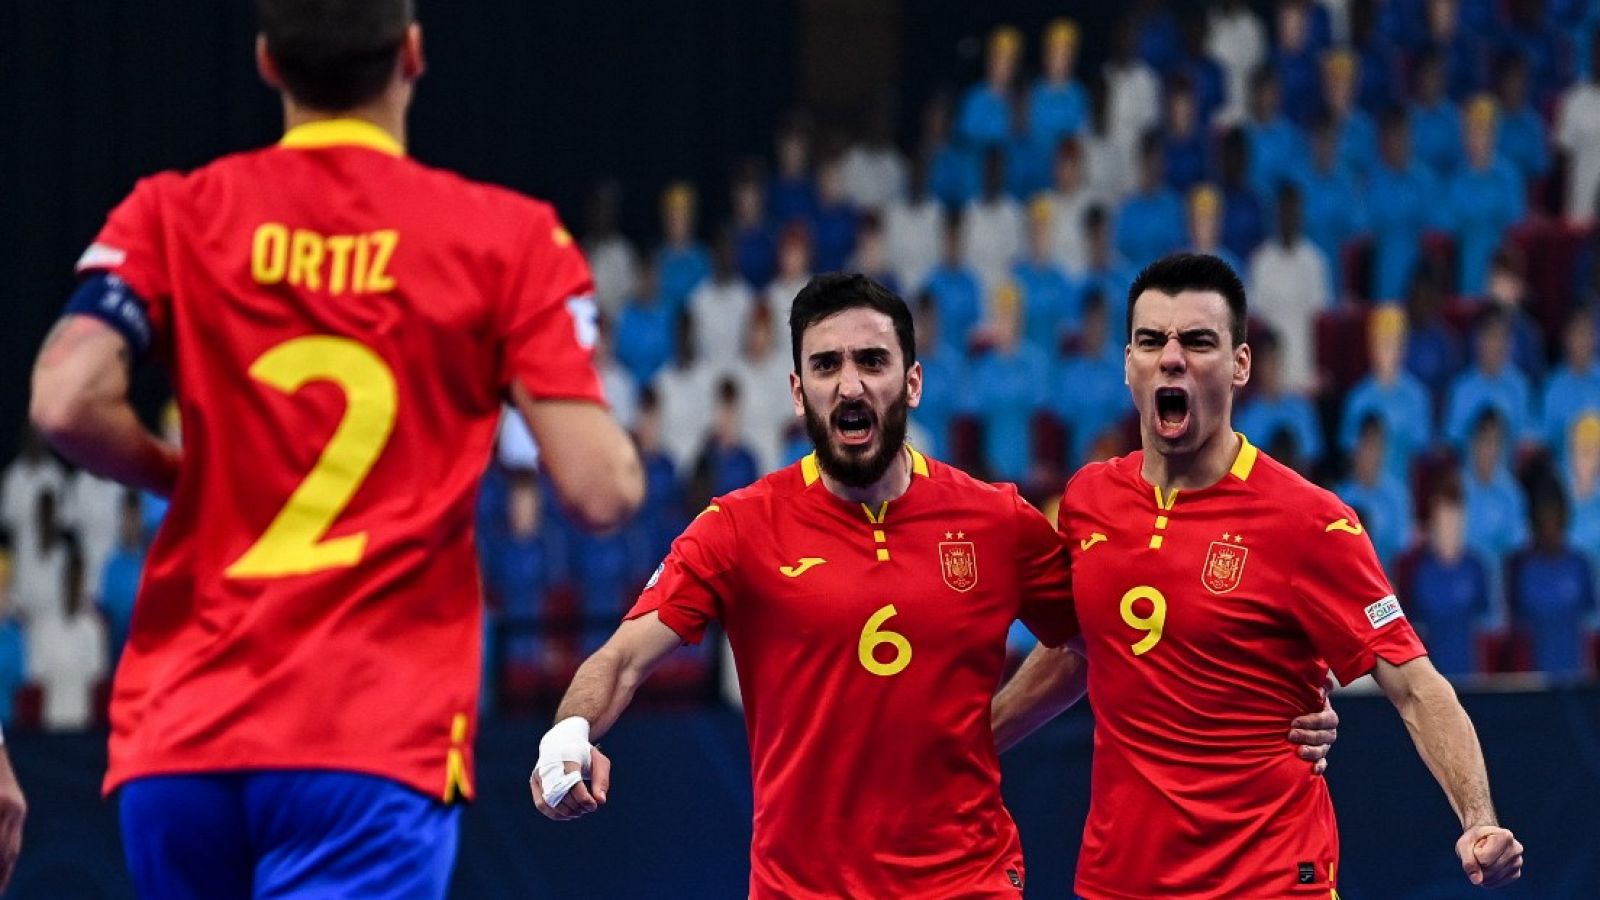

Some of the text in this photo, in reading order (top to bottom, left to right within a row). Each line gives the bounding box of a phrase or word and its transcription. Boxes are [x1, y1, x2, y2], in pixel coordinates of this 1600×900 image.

[252, 223, 398, 294] ORTIZ
[226, 335, 397, 577] 2
[857, 604, 913, 676] 6
[1119, 585, 1167, 656] 9
